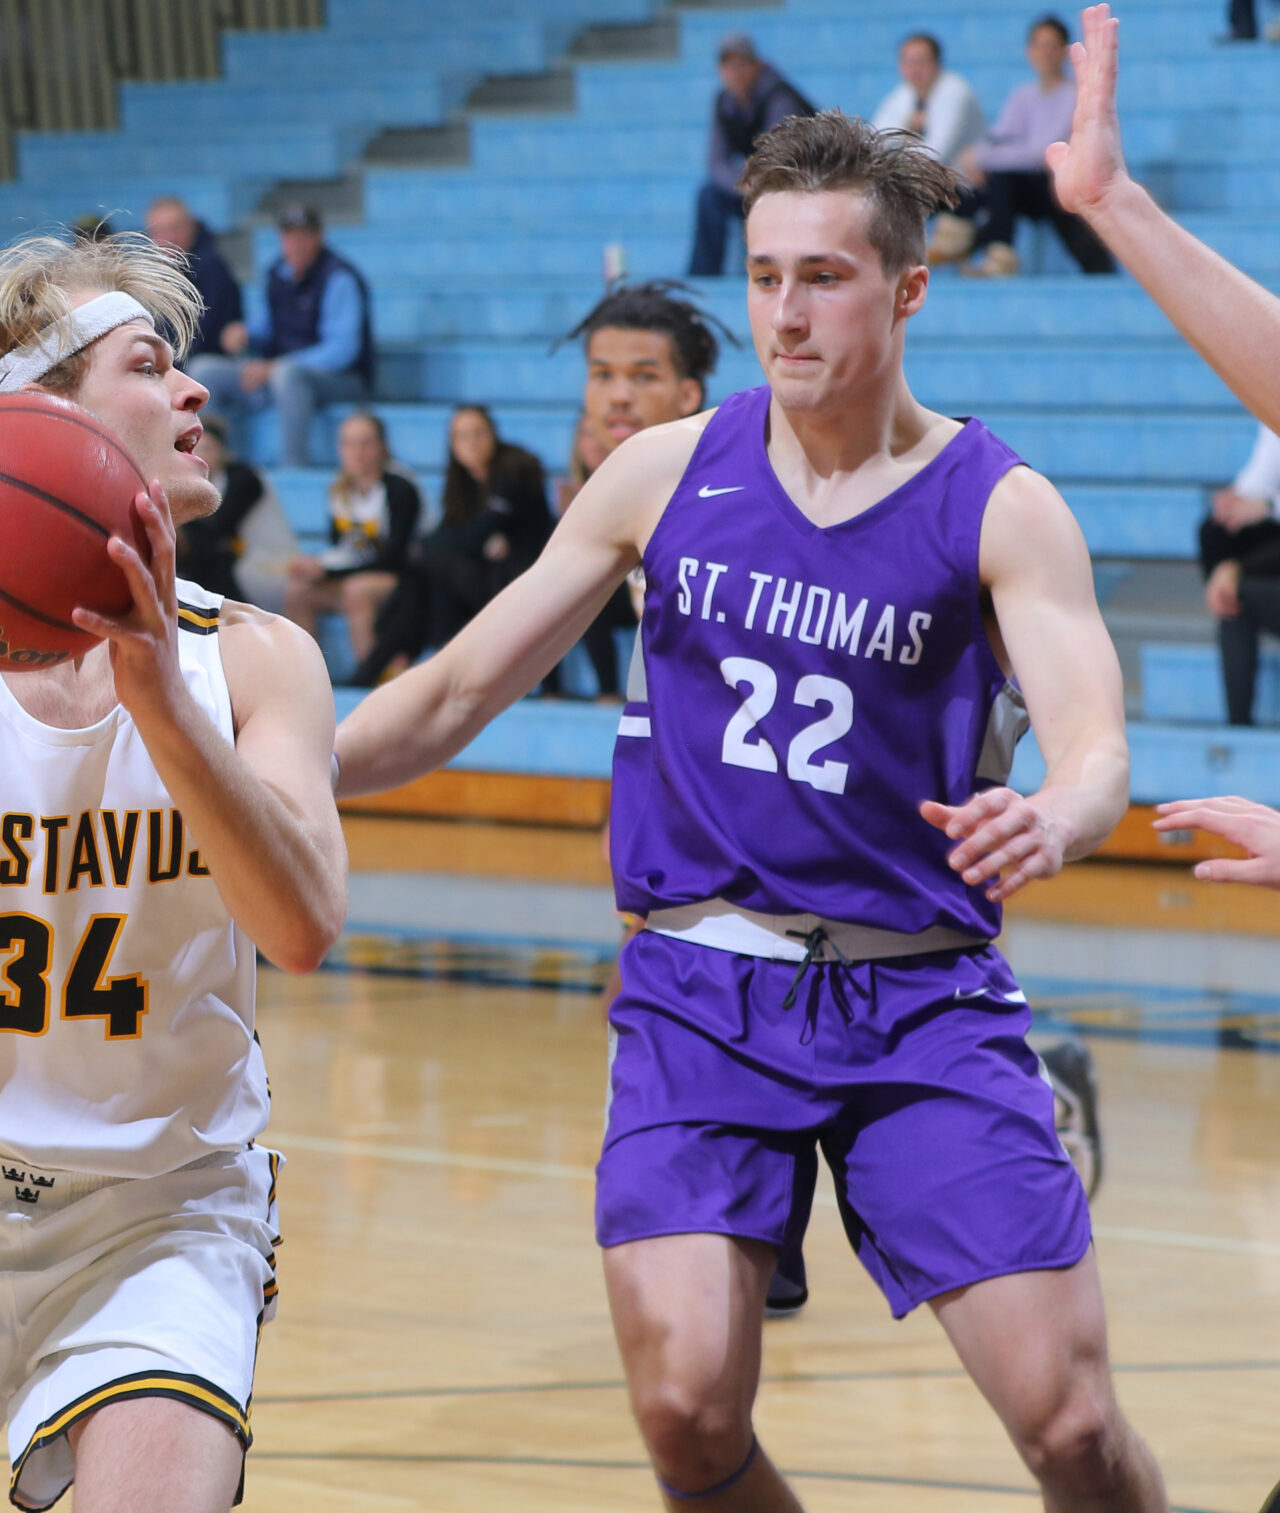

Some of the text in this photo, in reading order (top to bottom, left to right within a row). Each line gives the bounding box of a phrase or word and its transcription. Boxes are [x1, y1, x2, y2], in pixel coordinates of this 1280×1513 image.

[678, 557, 932, 665] ST. THOMAS
[720, 656, 854, 795] 22
